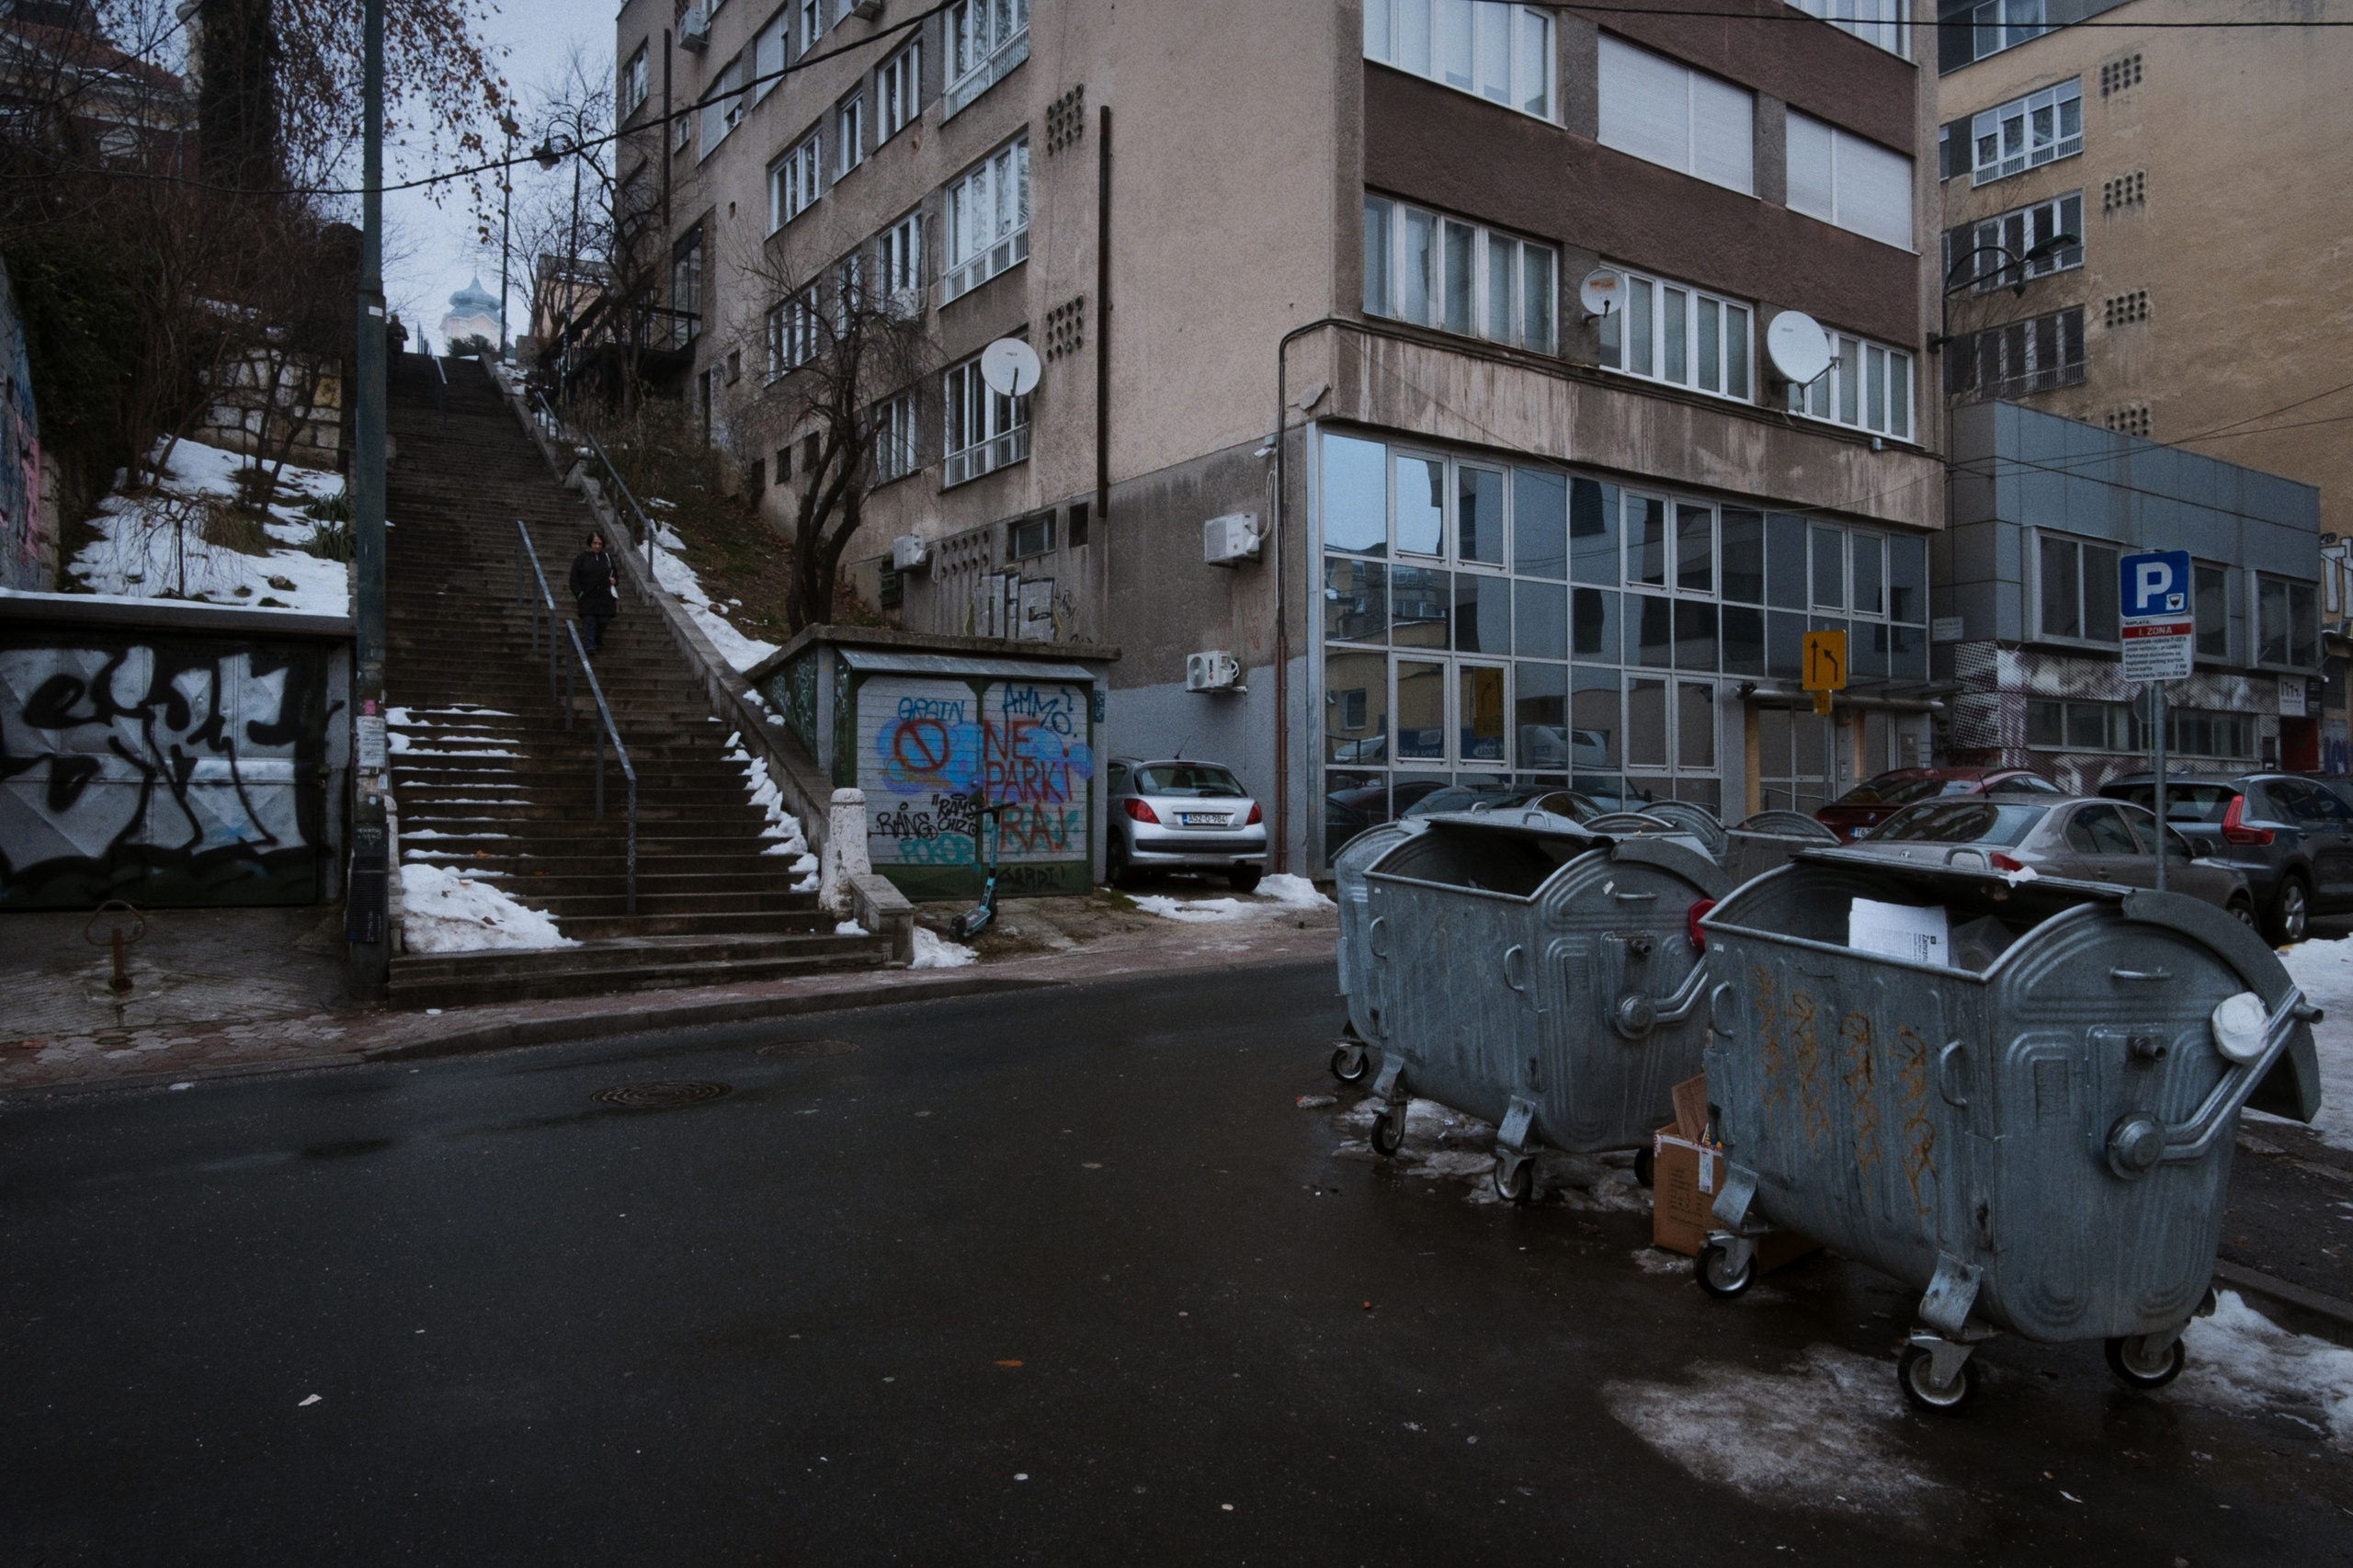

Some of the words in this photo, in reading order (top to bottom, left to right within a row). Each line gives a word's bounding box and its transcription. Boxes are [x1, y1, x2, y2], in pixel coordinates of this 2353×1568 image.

[2136, 562, 2173, 609] P
[2146, 626, 2173, 635] ZONA
[983, 719, 1040, 761] NE
